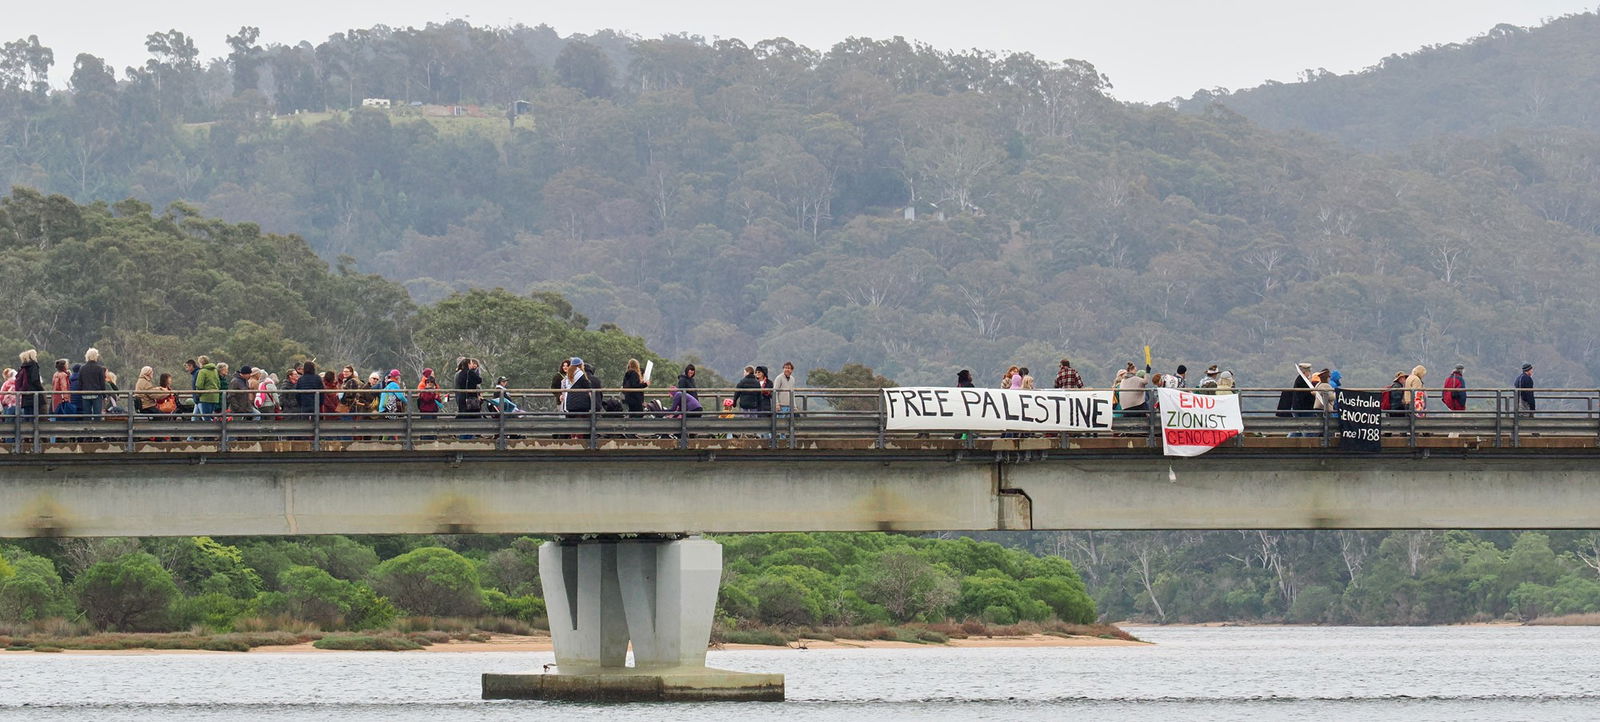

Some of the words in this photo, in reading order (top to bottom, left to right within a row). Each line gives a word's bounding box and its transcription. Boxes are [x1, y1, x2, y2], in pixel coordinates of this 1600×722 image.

[1180, 392, 1215, 409] END
[1338, 391, 1380, 408] Australia
[886, 390, 953, 418] FREE
[961, 390, 1109, 428] PALESTINE
[1339, 409, 1380, 425] ENOCIDE
[1167, 411, 1227, 429] ZIONIST
[1358, 428, 1380, 441] 1788
